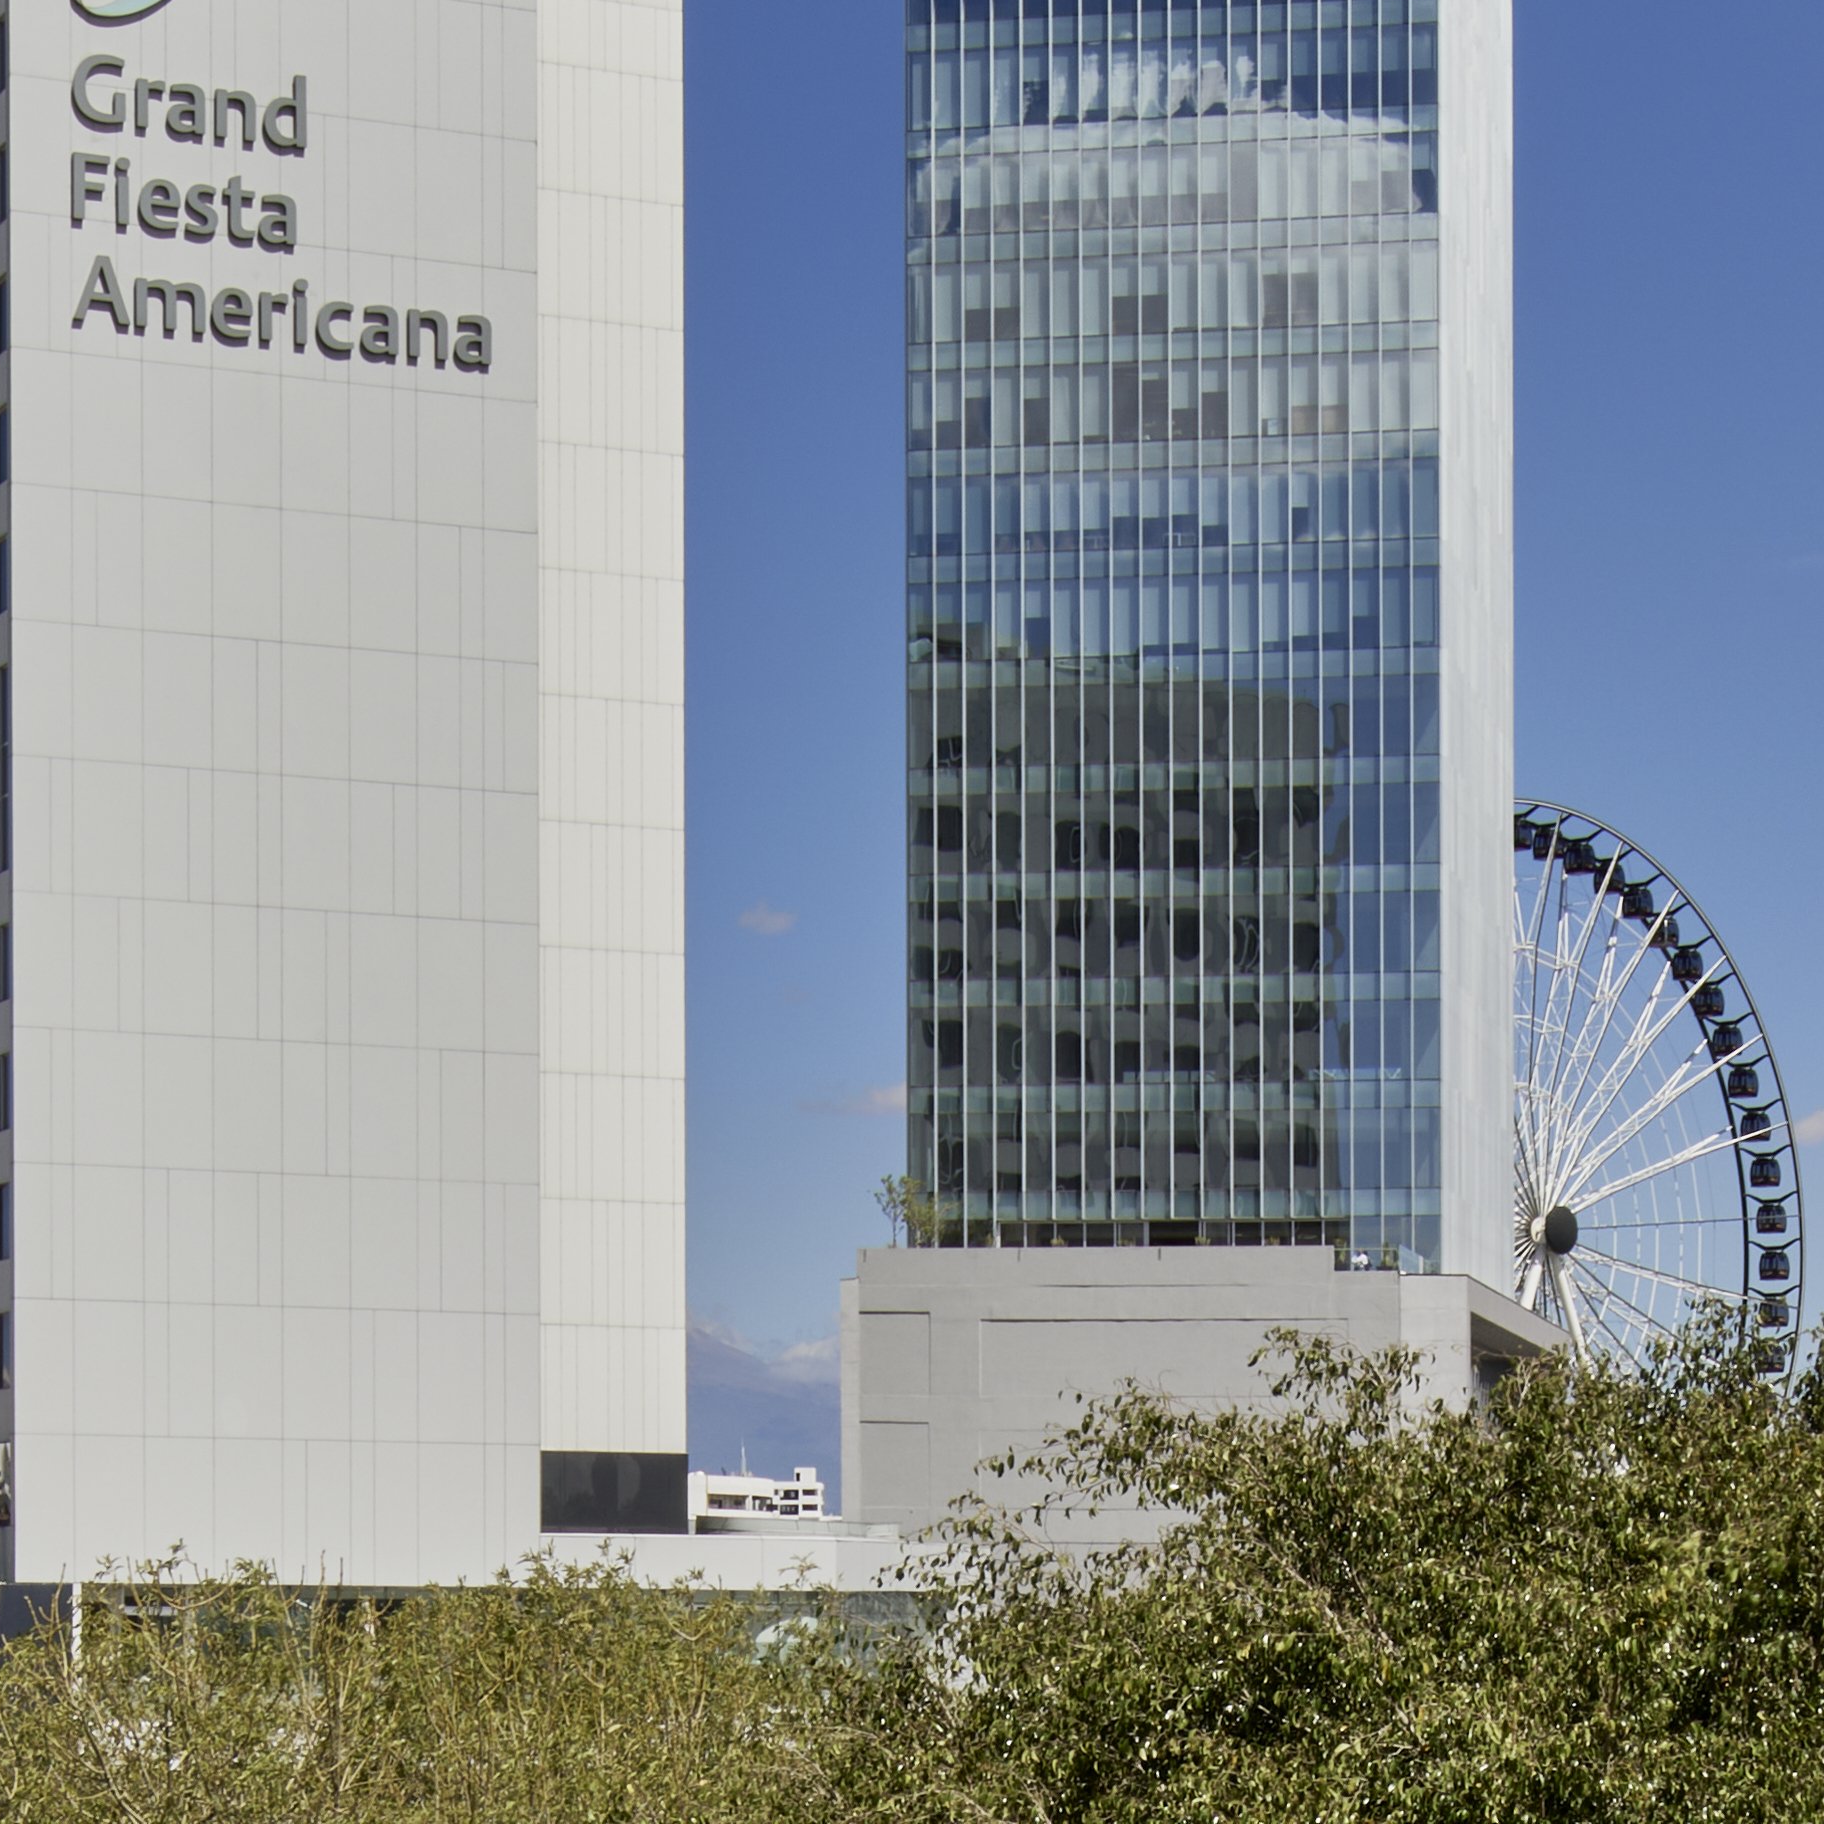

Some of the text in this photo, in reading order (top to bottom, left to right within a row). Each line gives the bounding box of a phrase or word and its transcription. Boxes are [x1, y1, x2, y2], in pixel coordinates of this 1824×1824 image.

[71, 54, 308, 155] Grand
[70, 151, 298, 251] Fiesta
[71, 255, 493, 371] Americana
